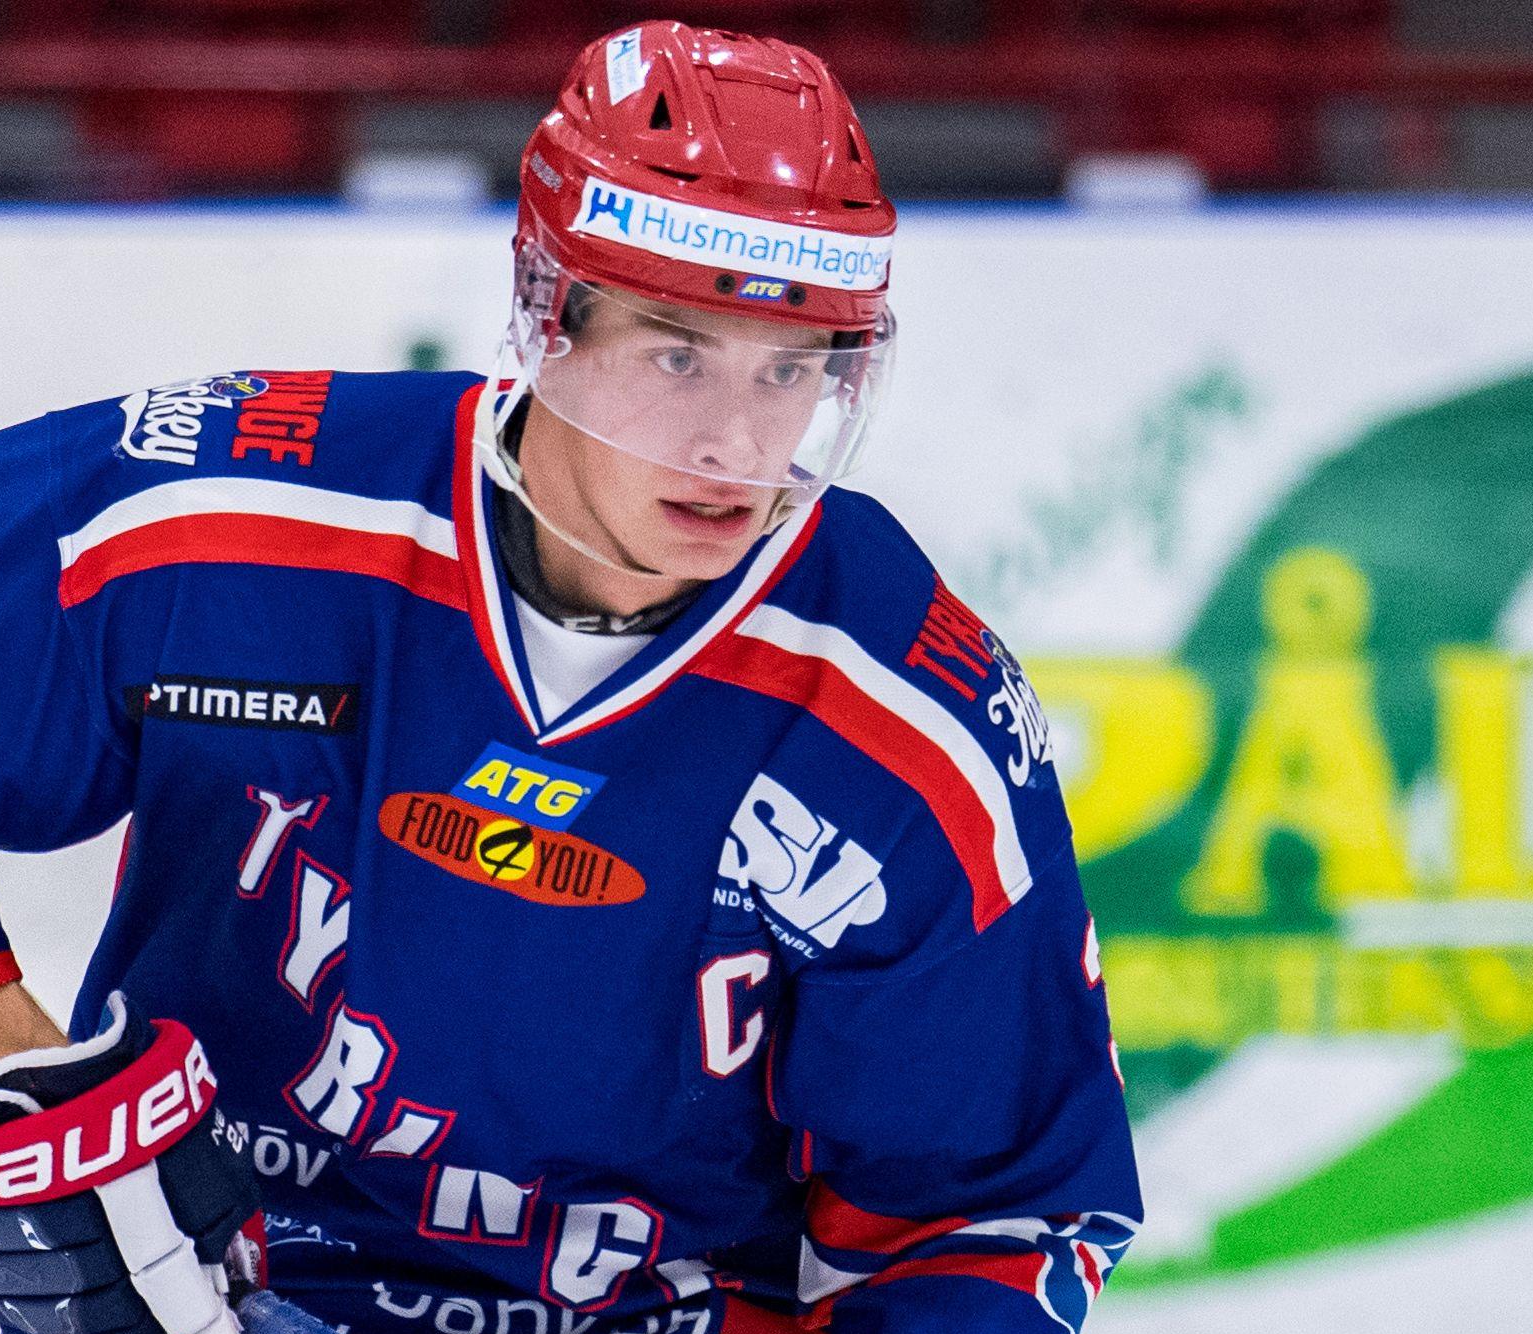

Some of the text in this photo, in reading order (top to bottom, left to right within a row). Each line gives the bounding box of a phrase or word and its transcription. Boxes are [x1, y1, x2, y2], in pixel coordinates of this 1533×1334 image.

[641, 206, 891, 285] HusmanHagbe
[741, 280, 784, 298] ATG
[464, 758, 583, 818] ATG
[398, 796, 614, 901] FOOD 4 YOU!
[696, 948, 772, 1080] C
